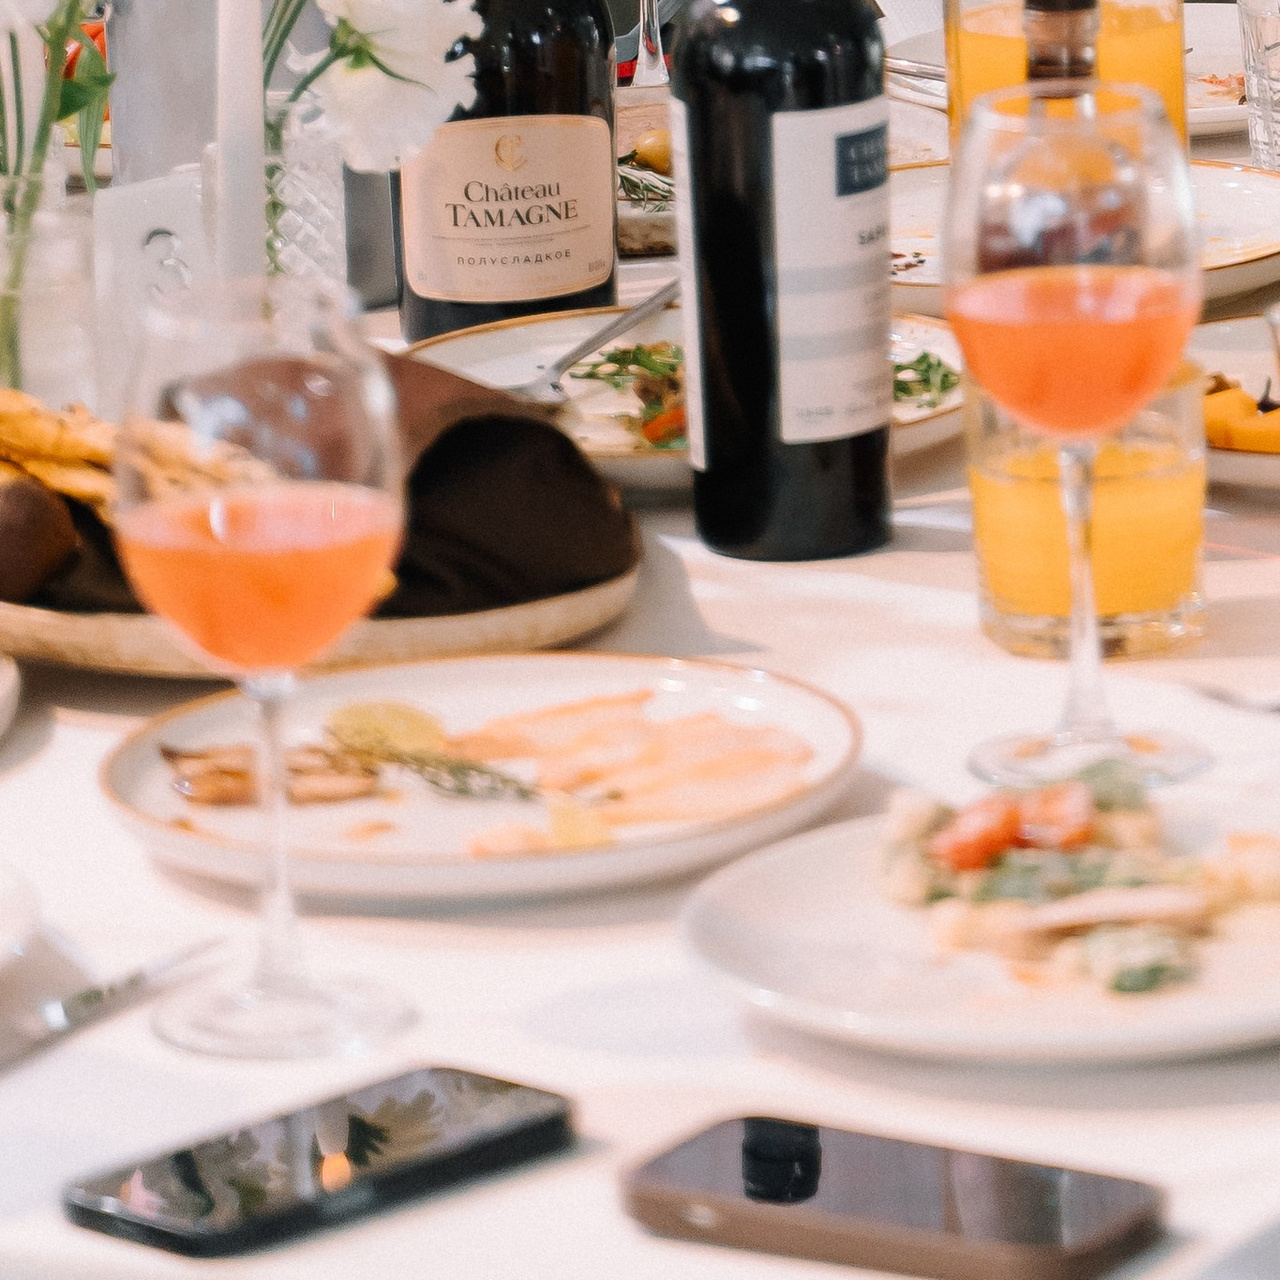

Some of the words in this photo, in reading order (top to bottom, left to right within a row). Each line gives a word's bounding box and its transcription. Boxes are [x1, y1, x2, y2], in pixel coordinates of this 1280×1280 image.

[463, 180, 562, 203] Château
[444, 199, 579, 228] TAMAGNE
[457, 248, 572, 266] ПОЛУСЛАДКОЕ
